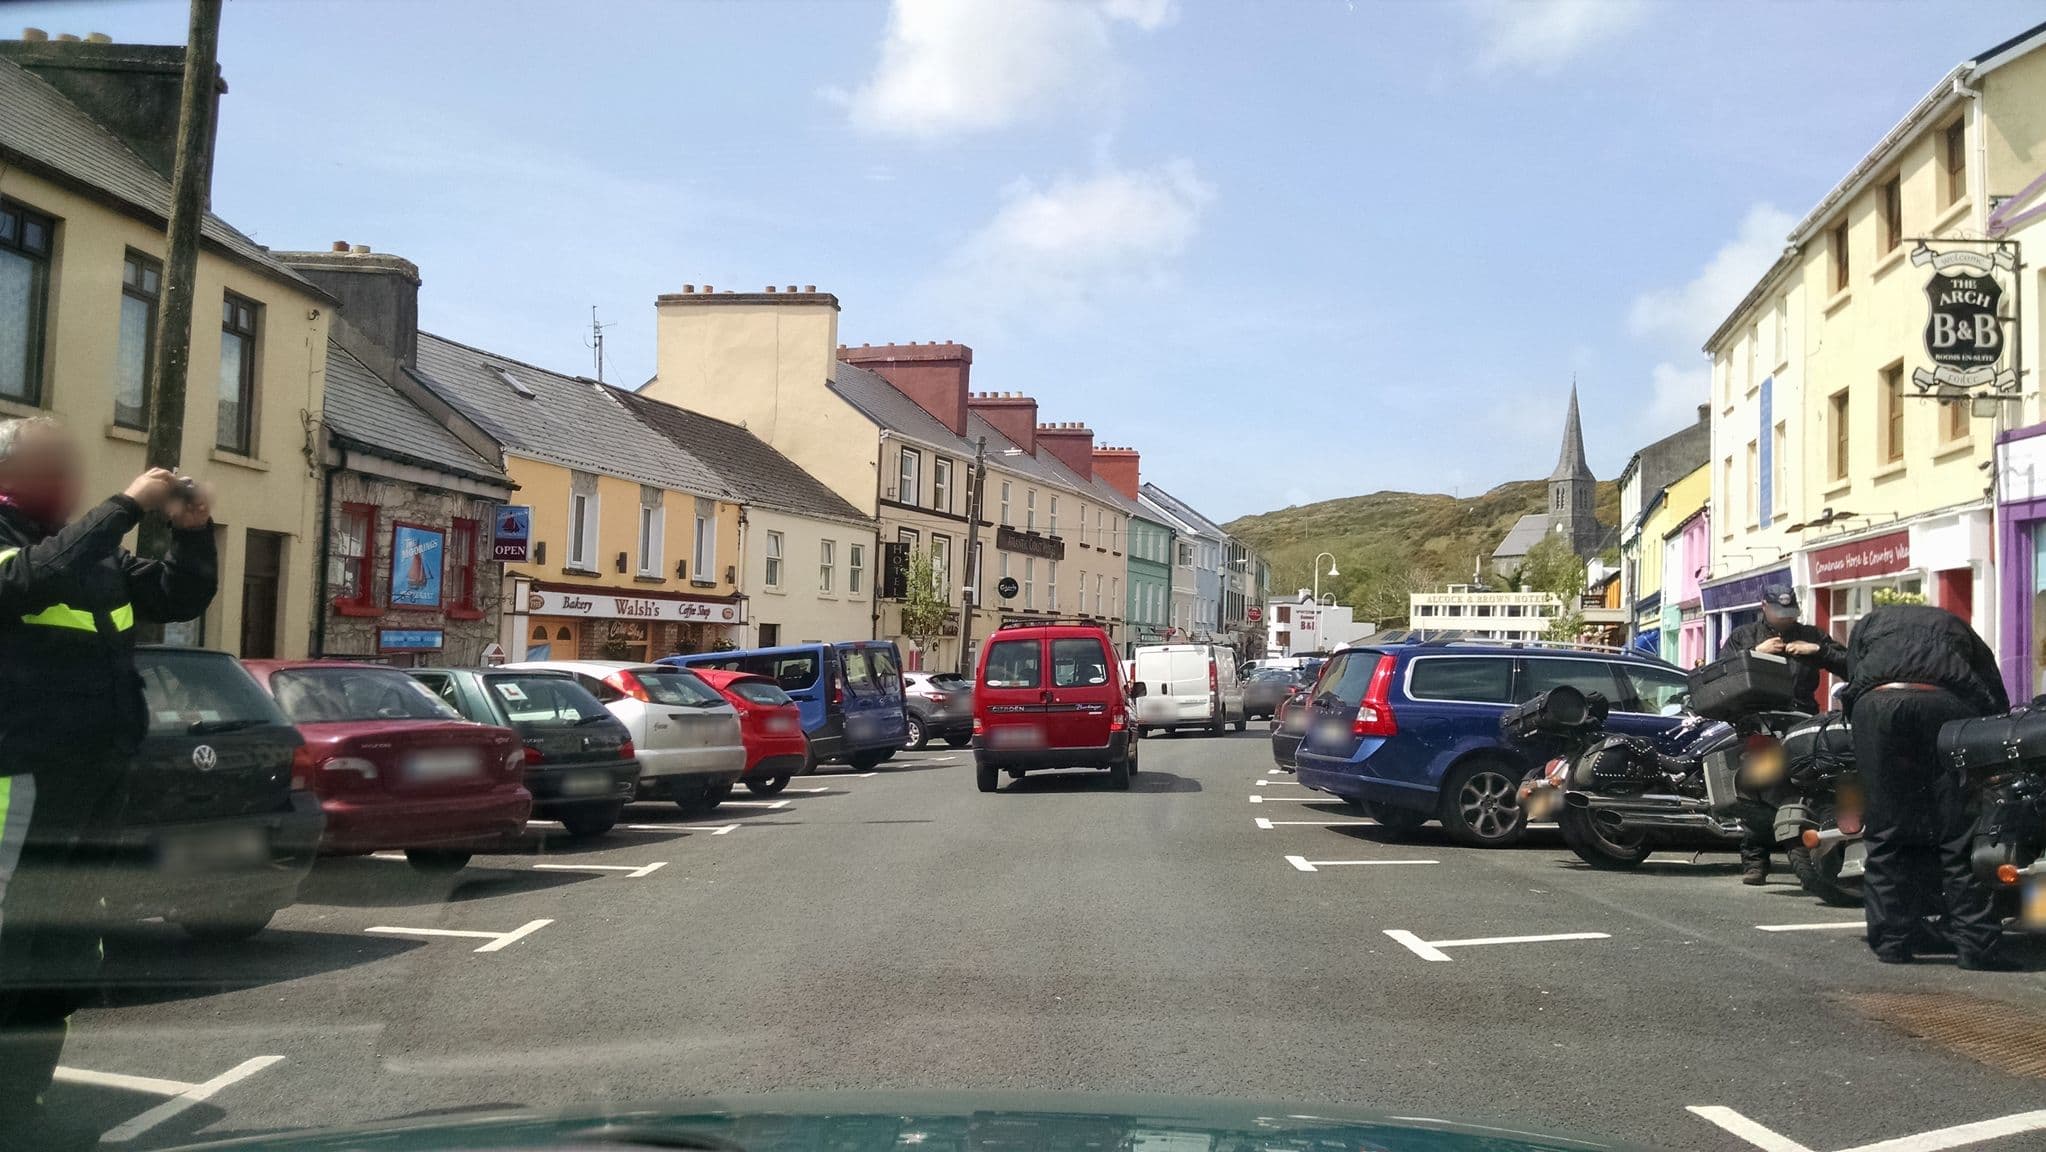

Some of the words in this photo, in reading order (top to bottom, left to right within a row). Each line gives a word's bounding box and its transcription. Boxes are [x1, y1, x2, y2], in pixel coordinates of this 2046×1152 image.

[1950, 279, 1977, 289] THE
[1939, 290, 1991, 308] ARCH
[1932, 313, 1998, 348] B&B
[495, 545, 526, 555] OPEN
[1845, 552, 1862, 567] Horse
[1862, 551, 1869, 566] &
[1869, 547, 1894, 564] Country
[893, 544, 902, 596] HOTEL
[562, 596, 593, 613] Bakery
[615, 599, 660, 617] Walsh's
[679, 603, 696, 618] Coffee
[697, 604, 710, 619] Shop
[1427, 594, 1464, 604] ALCOCK
[1467, 594, 1473, 603] &
[1477, 593, 1511, 603] BROWN
